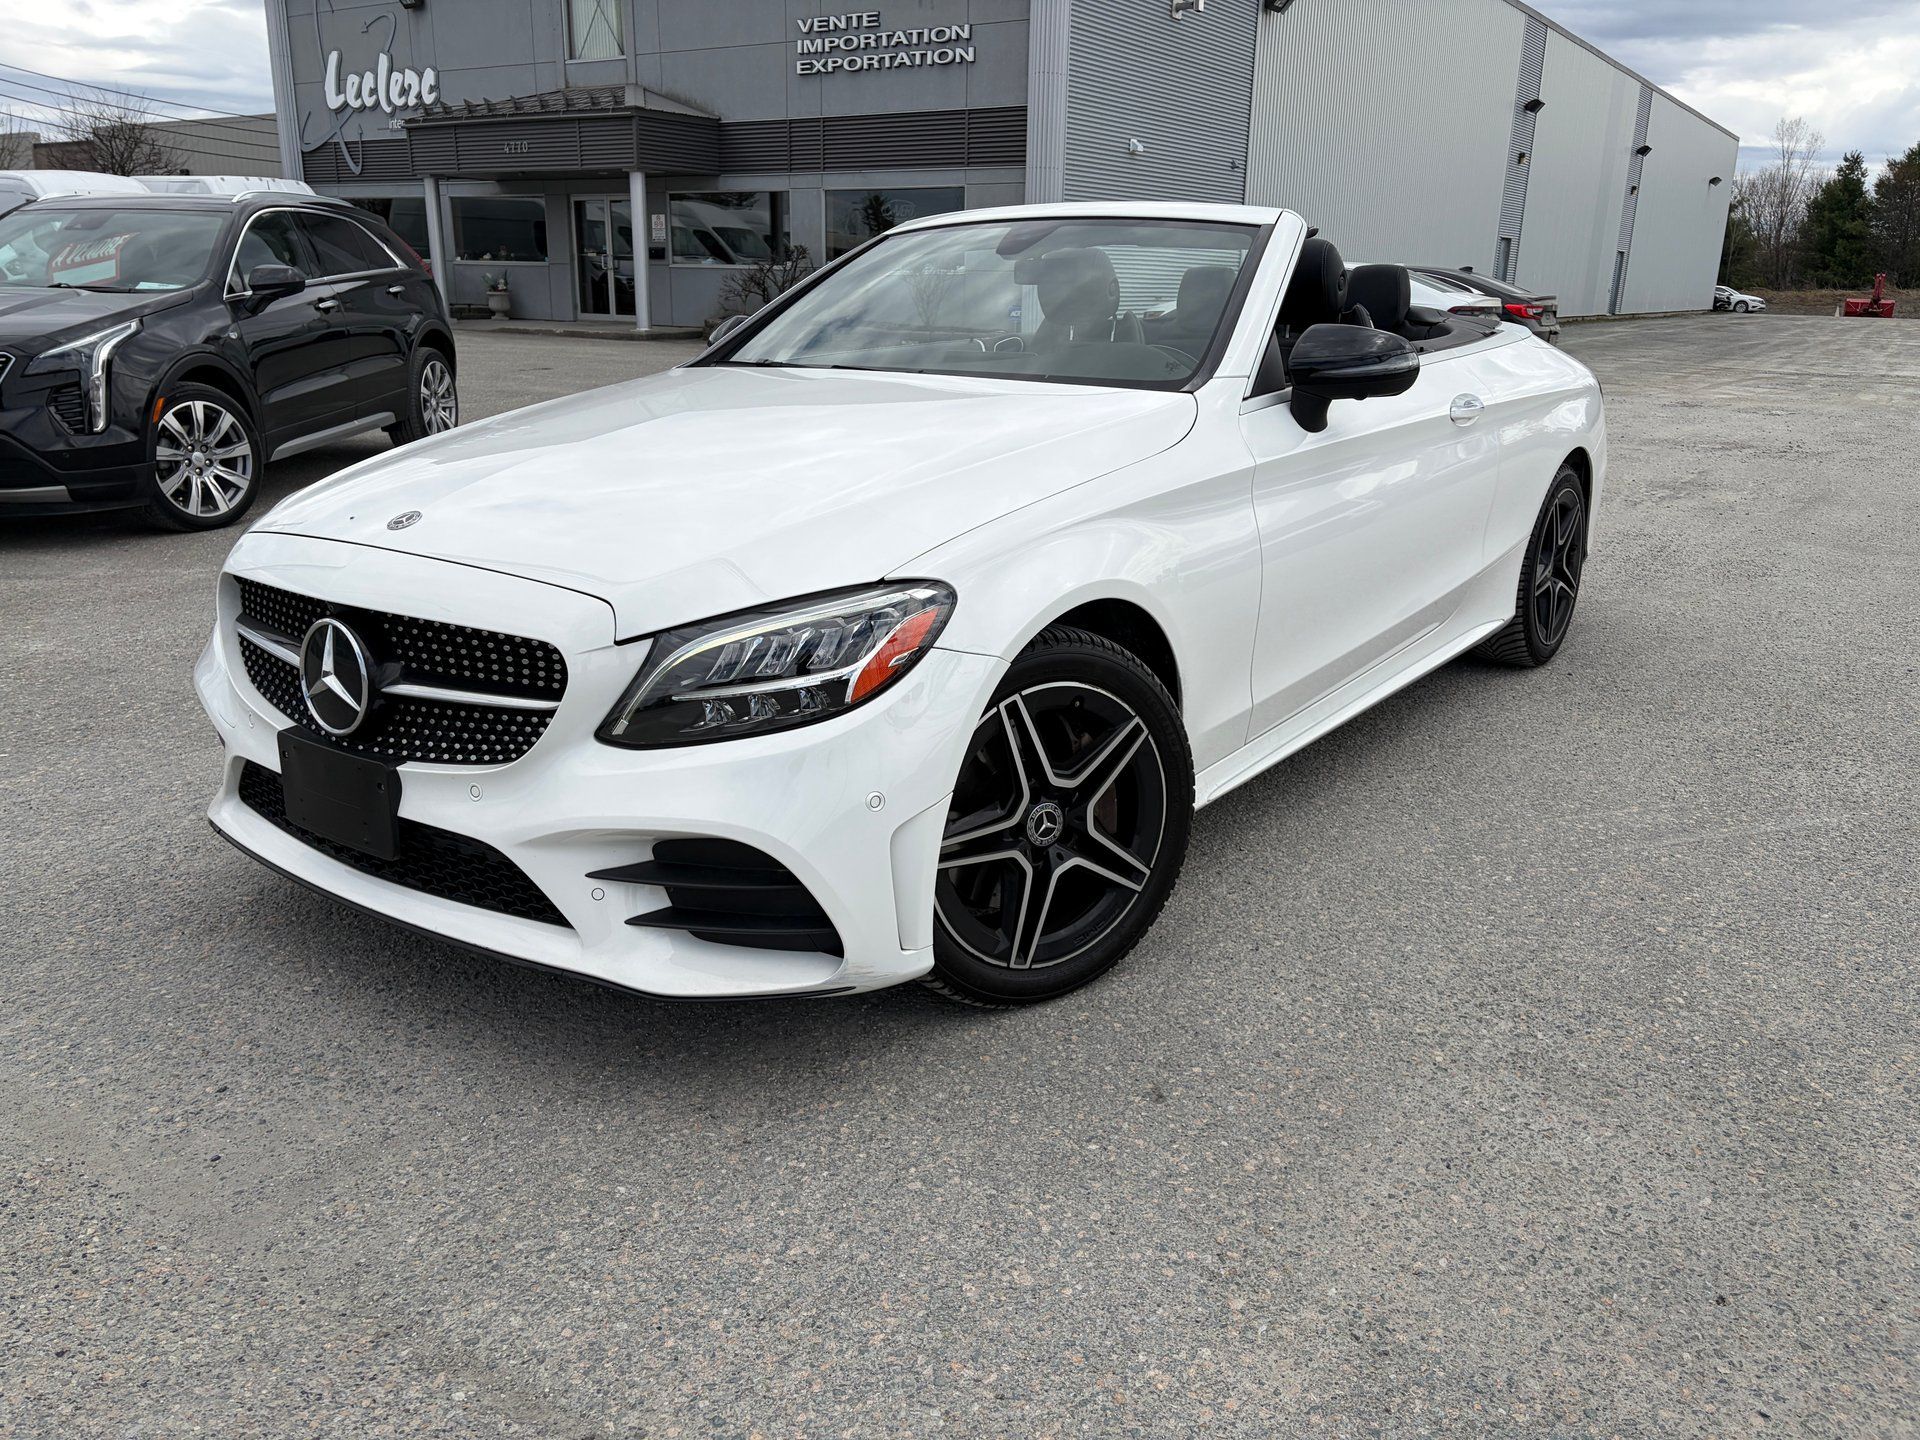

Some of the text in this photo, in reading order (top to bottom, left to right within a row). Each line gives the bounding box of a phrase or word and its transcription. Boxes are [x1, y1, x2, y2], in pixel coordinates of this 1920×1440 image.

[797, 11, 880, 33] VENTE
[797, 24, 971, 54] IMPORTATION
[796, 46, 976, 75] EXPORTATION
[325, 51, 439, 114] Leclerc
